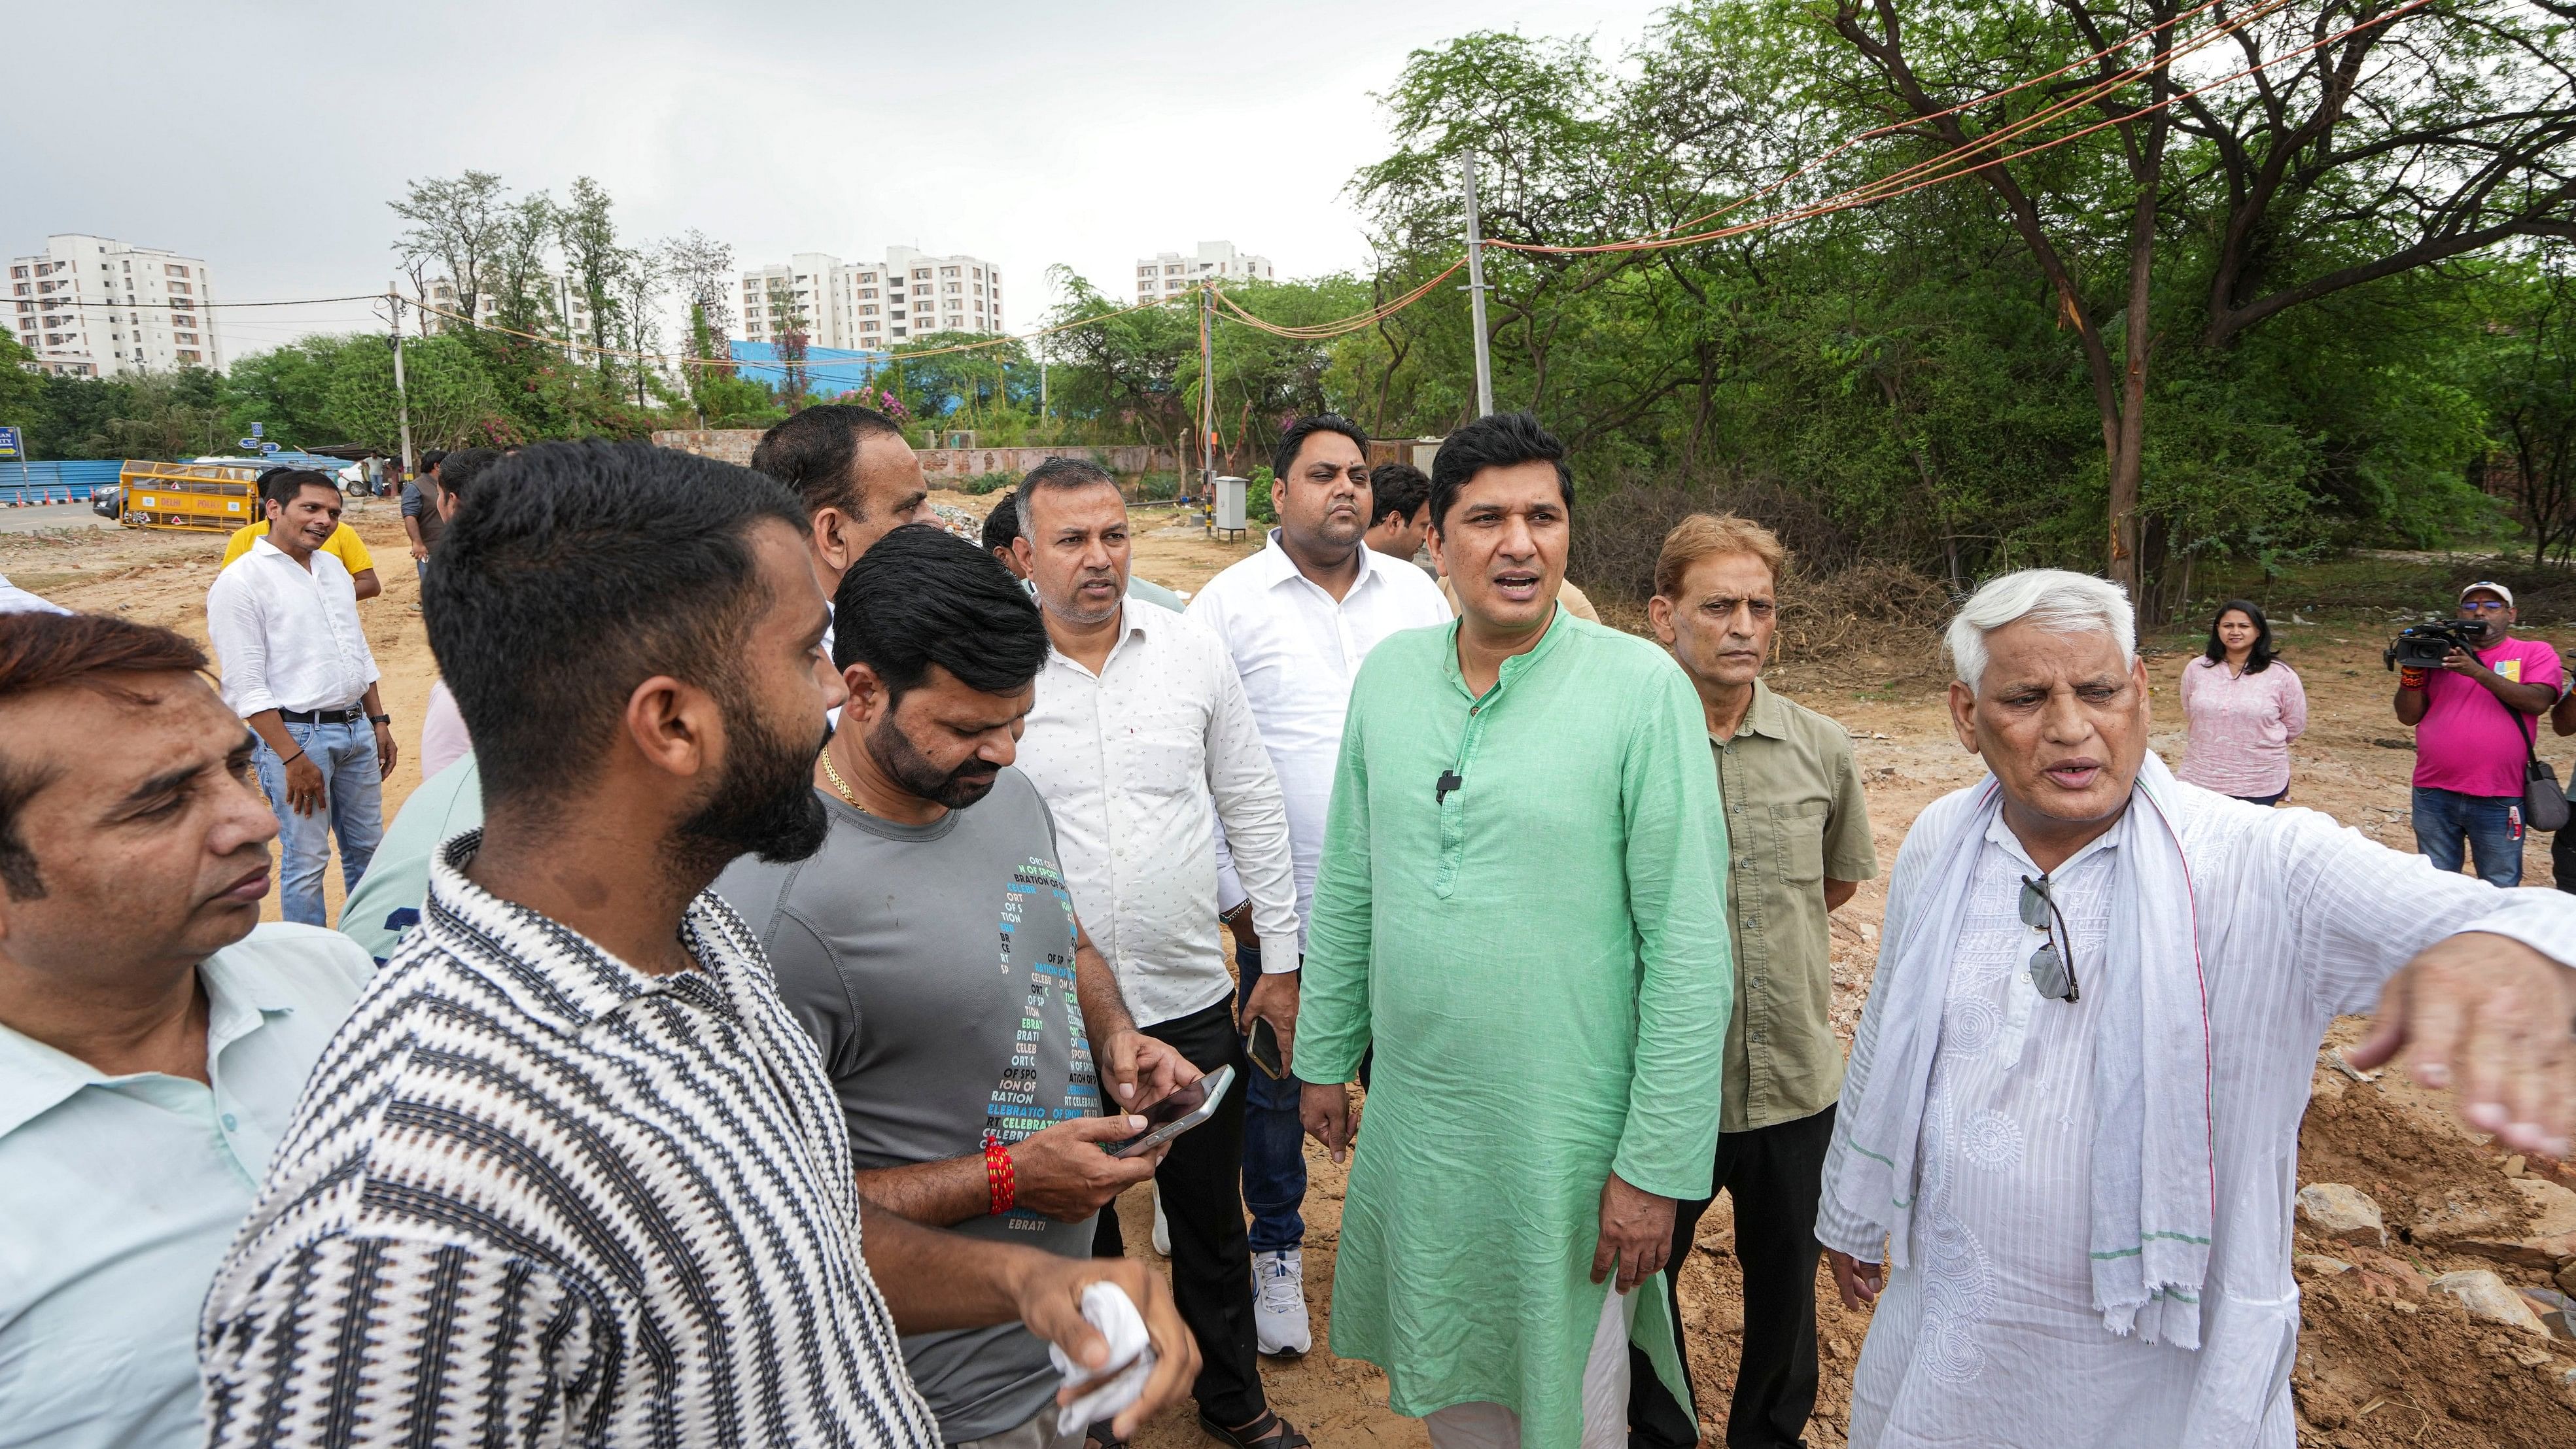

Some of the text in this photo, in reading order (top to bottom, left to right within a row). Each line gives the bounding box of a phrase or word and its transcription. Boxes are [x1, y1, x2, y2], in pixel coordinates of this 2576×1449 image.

[161, 497, 181, 507] DELHI
[1029, 856, 1044, 866] ORT
[1018, 864, 1058, 880] N OF SPORT
[1014, 873, 1049, 886] BRATION
[1050, 879, 1059, 888] OF
[1007, 882, 1037, 895] CELEBR
[1006, 892, 1023, 903] ORT
[1005, 902, 1022, 913] OF S
[1000, 911, 1021, 924] TION
[1000, 932, 1011, 943] BR
[1001, 943, 1011, 954] CE
[1000, 953, 1009, 964] RT
[1047, 953, 1056, 964] OF
[1057, 955, 1064, 966] SP
[1000, 964, 1009, 975] SP
[1035, 962, 1058, 976] RATION
[1058, 968, 1068, 978] OF
[1031, 972, 1053, 986] CELEBR
[1059, 979, 1068, 990] ON
[1031, 984, 1049, 997] ORT C
[1028, 995, 1045, 1007] OF SP
[1064, 992, 1077, 1004] TION
[1024, 1005, 1040, 1017] TION
[1022, 1017, 1043, 1030] EBRAT
[1017, 1030, 1039, 1042] BRATI
[1070, 1037, 1078, 1047] OF
[1015, 1042, 1037, 1055] CELEB
[1011, 1055, 1035, 1067] ORT C
[1070, 1060, 1075, 1070] N
[1075, 1060, 1083, 1072] OF
[1003, 1068, 1037, 1080] OF SPO
[1069, 1072, 1086, 1084] ATION
[999, 1079, 1036, 1092] ION OF
[991, 1091, 1034, 1104] RATION
[1064, 1096, 1071, 1107] RT
[987, 1103, 1046, 1119] ELEBRATIO
[1053, 1108, 1063, 1119] OF
[1065, 1109, 1083, 1120] SPORT
[986, 1116, 1001, 1127] RT
[1008, 1219, 1047, 1231] EBRATI
